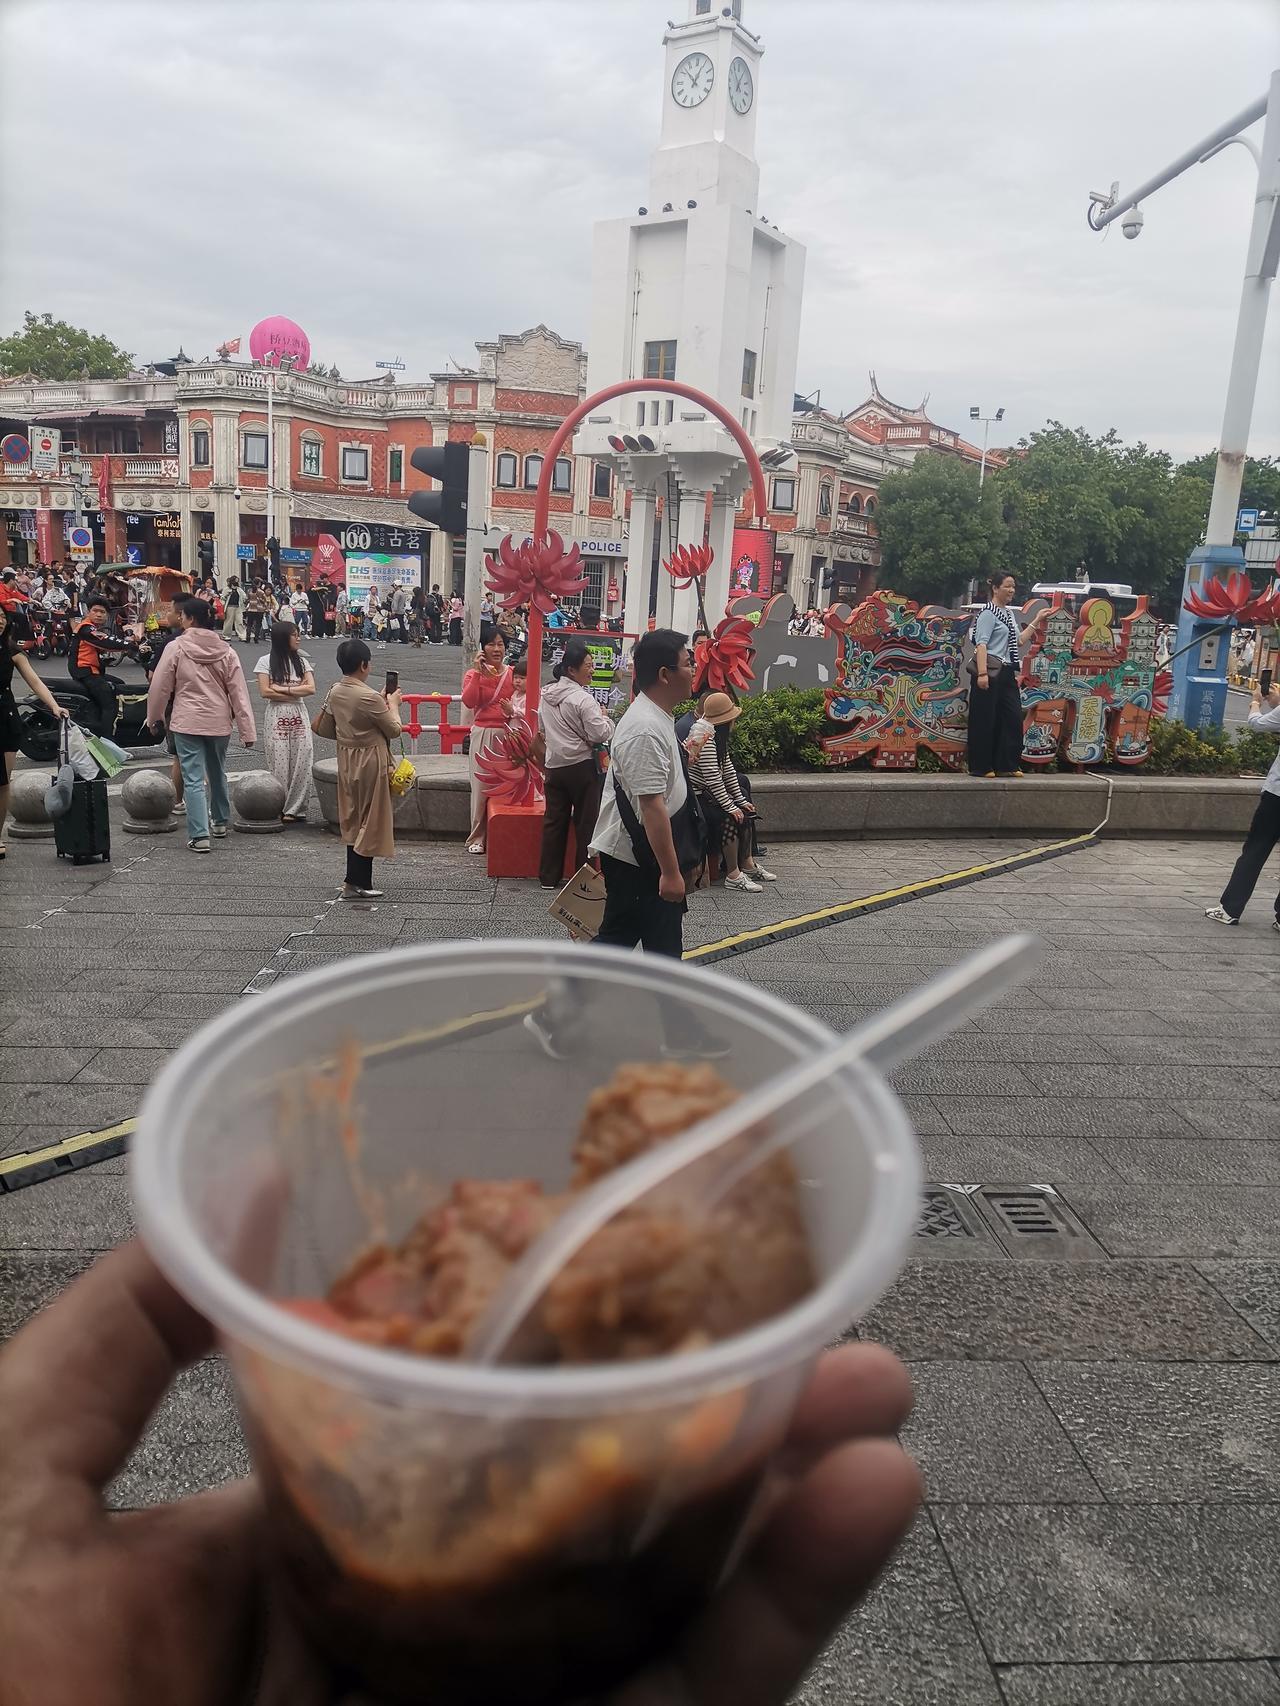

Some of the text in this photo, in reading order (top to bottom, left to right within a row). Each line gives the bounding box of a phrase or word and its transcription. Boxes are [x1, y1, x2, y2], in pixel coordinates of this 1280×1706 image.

[387, 528, 422, 549] 古茗
[581, 541, 622, 553] POLICE
[549, 648, 629, 671] 泉古城
